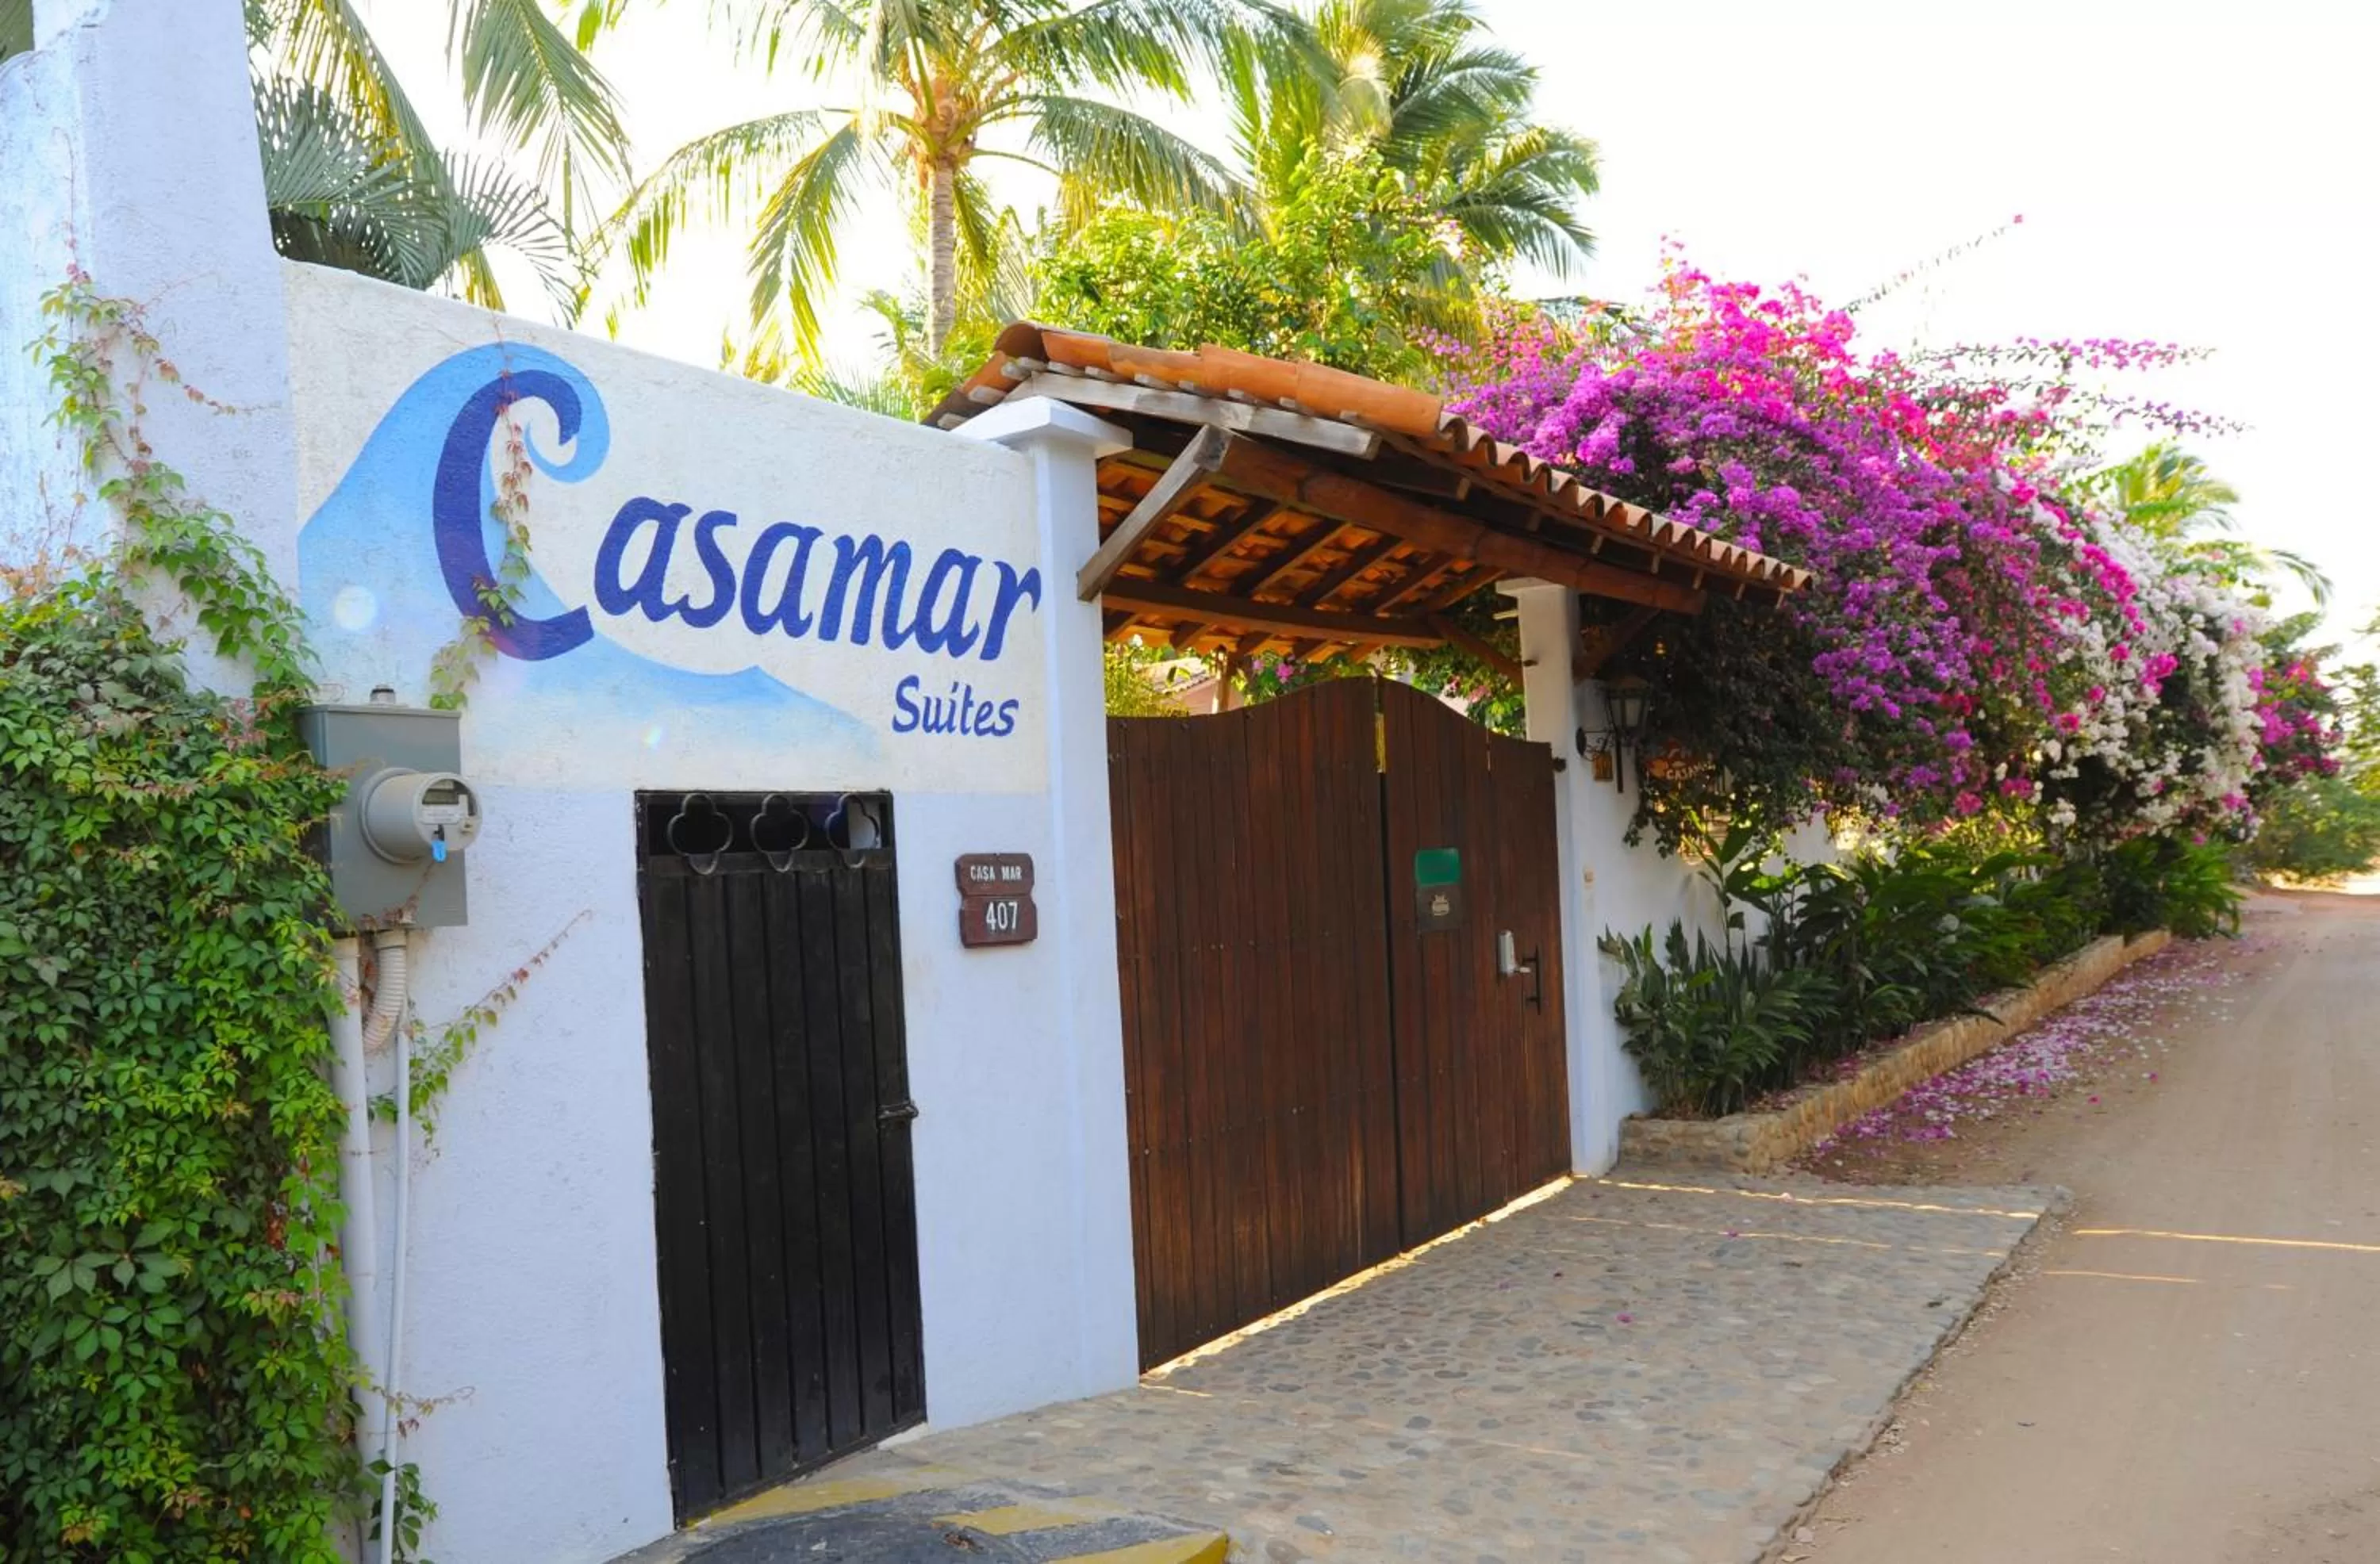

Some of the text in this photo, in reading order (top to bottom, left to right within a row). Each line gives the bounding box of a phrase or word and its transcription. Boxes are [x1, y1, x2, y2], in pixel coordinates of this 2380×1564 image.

[432, 369, 1042, 661] Casamar
[891, 673, 1020, 738] Suites
[969, 864, 1023, 883] CASA MAR
[985, 900, 1019, 931] 407
